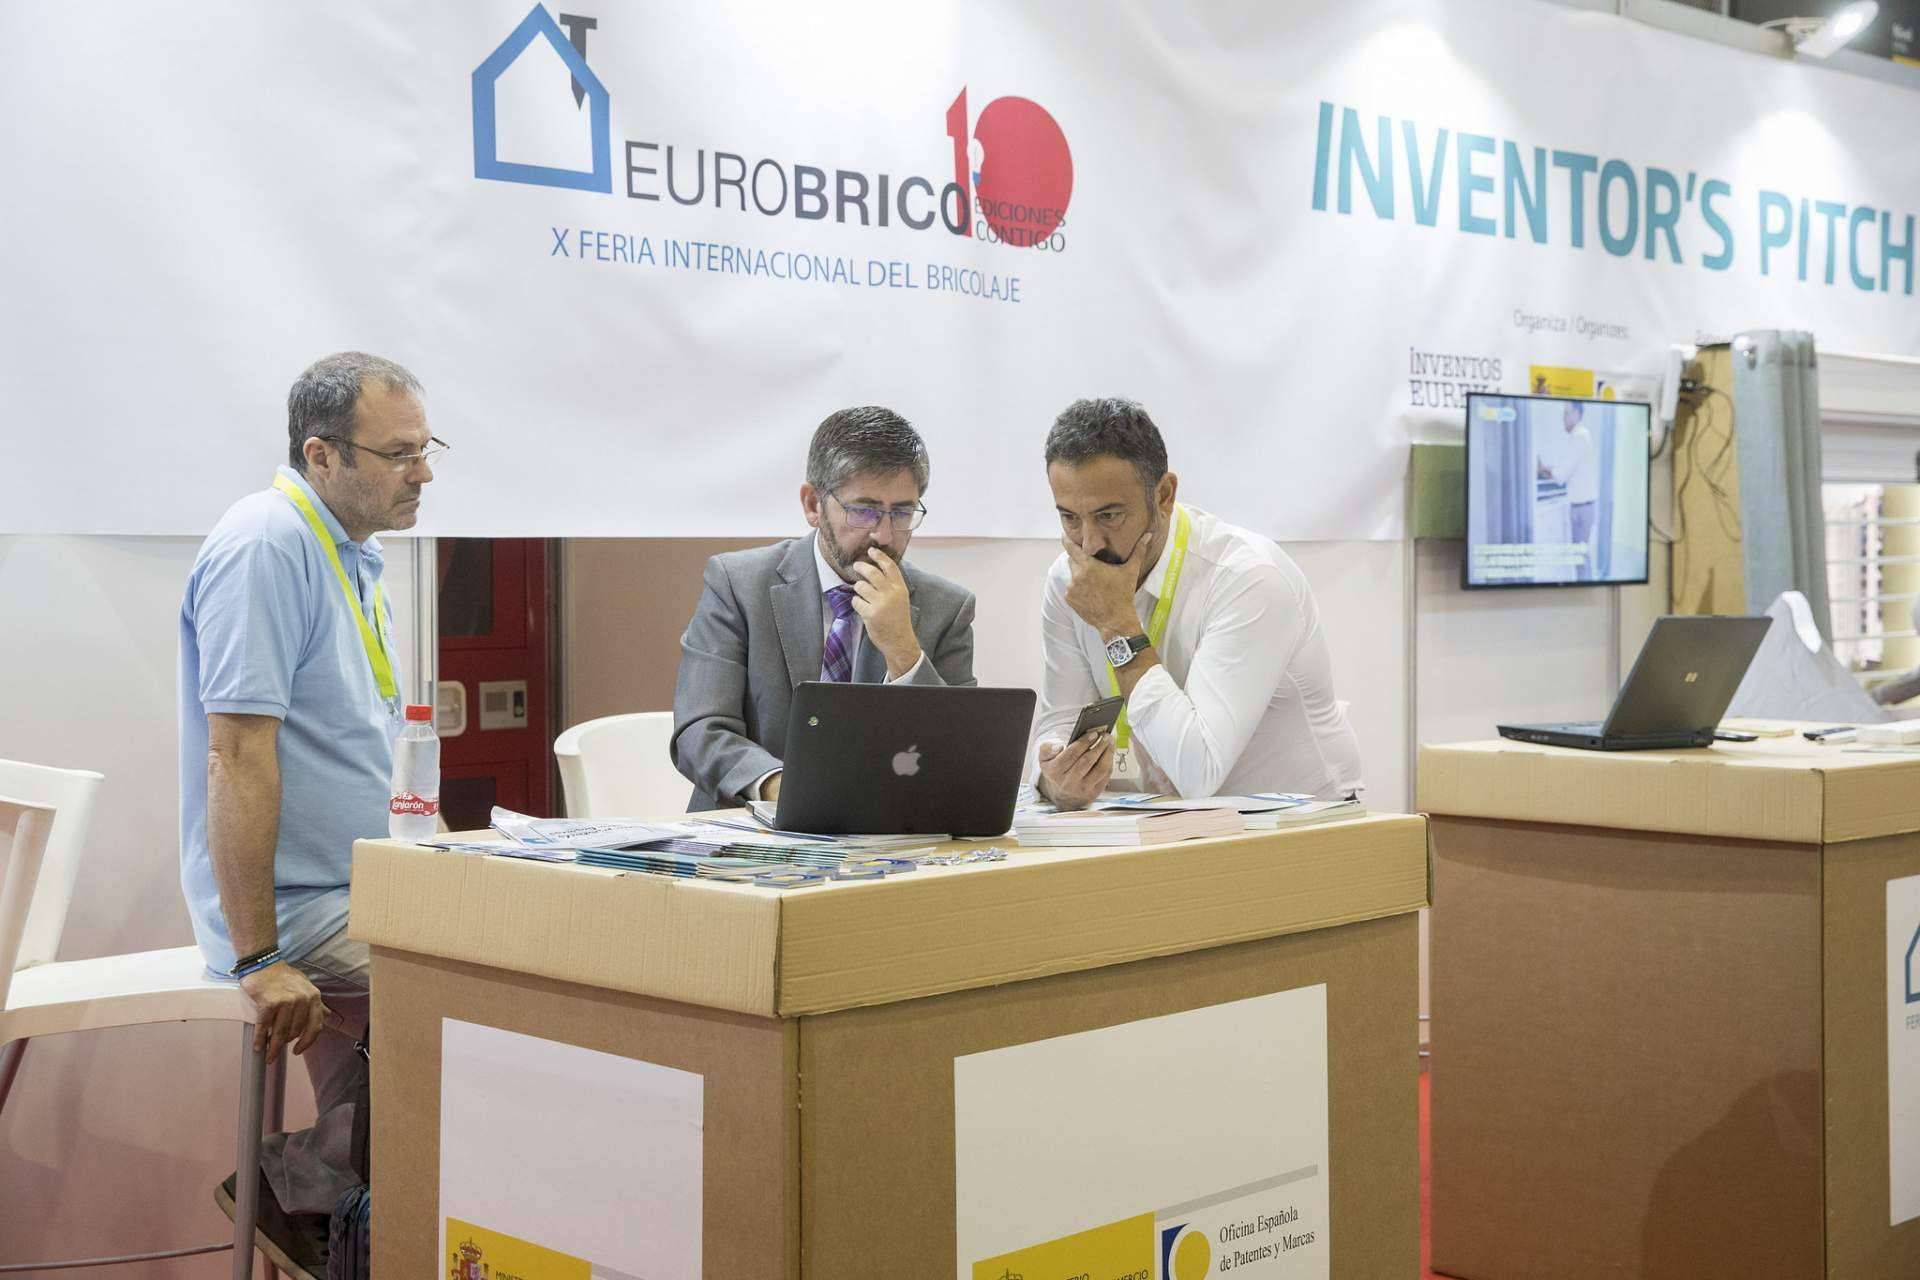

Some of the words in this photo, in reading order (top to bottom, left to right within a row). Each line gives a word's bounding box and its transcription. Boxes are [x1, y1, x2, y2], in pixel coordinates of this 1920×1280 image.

[624, 140, 970, 236] EUROBRICO
[1311, 100, 1735, 272] INVENTOR'S
[1757, 190, 1916, 297] PITCH
[975, 196, 1066, 227] EDICIONES
[976, 220, 1066, 252] CONTIGO
[551, 227, 570, 257] X
[579, 231, 655, 266] FERIA
[664, 239, 860, 286] INTERNACIONAL
[868, 260, 919, 289] DEL
[927, 263, 1022, 303] BRICOLAJE
[1220, 1221, 1255, 1243] Oficina
[1257, 1206, 1299, 1233] Española
[1220, 1254, 1232, 1272] de
[1233, 1245, 1272, 1267] Patentes
[1273, 1242, 1281, 1259] y
[1282, 1231, 1315, 1252] Marcas
